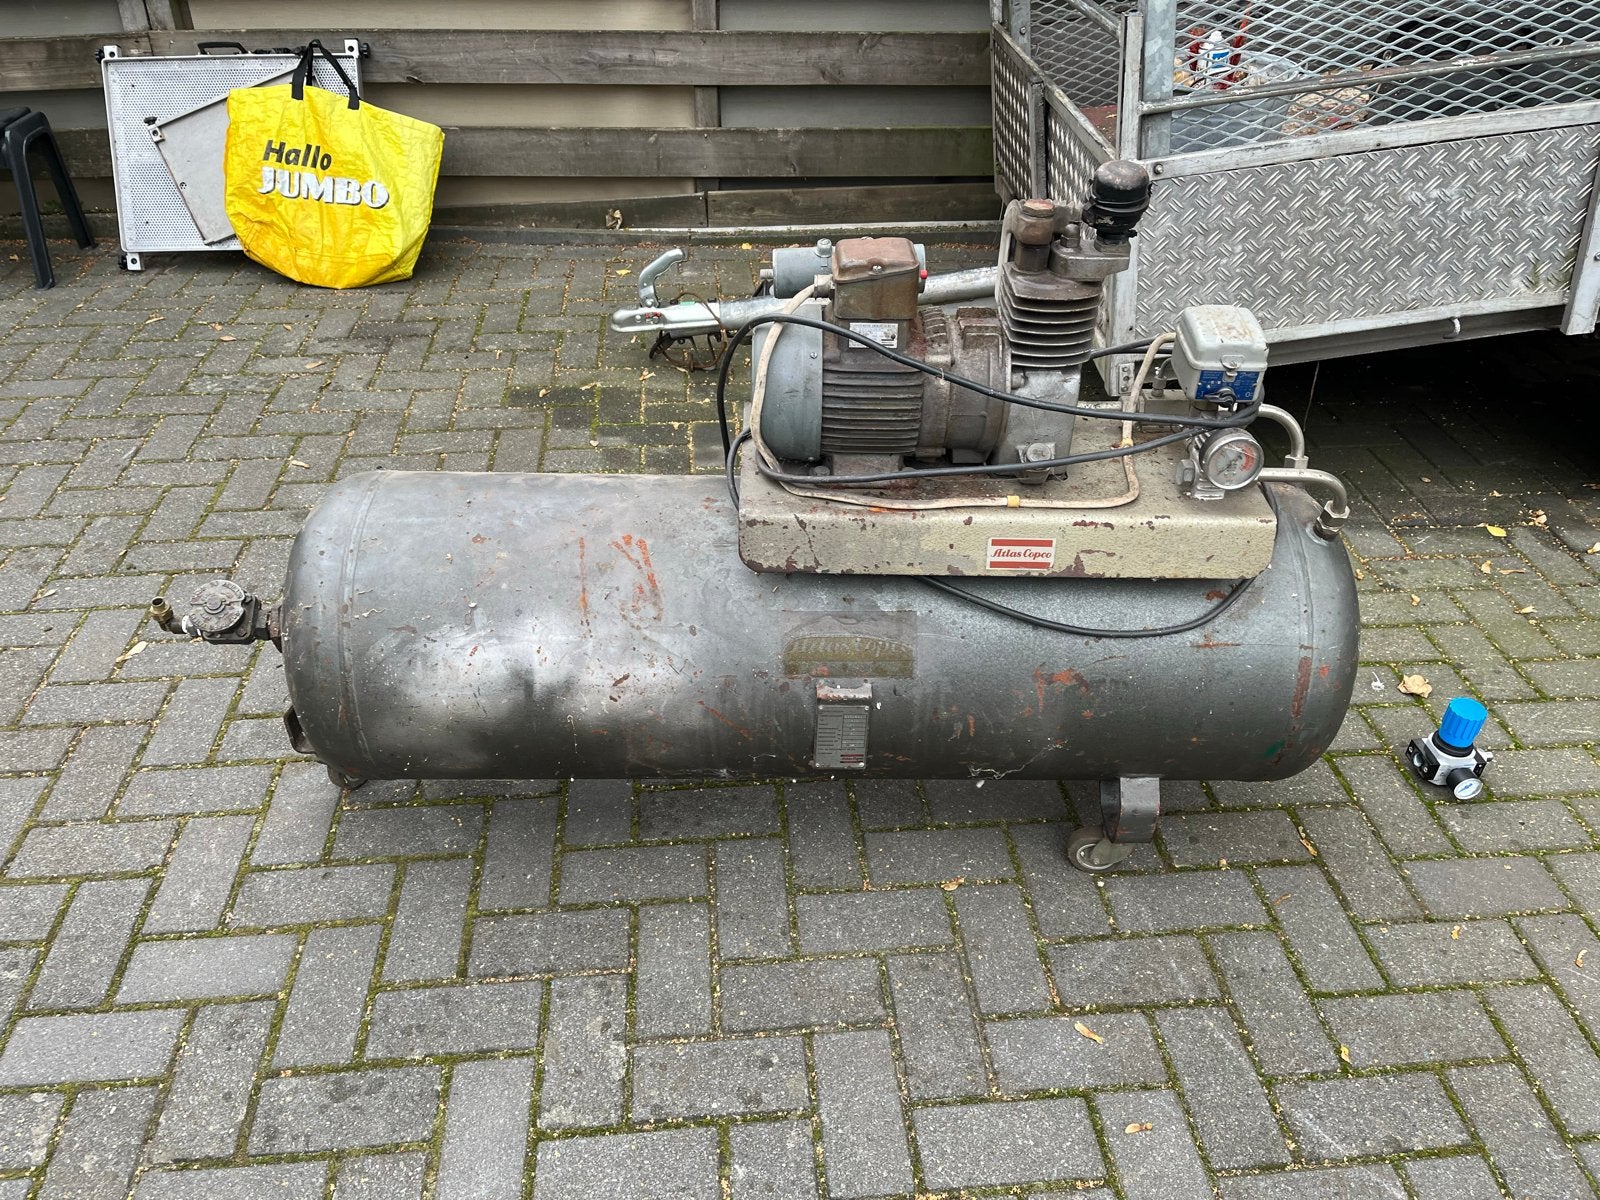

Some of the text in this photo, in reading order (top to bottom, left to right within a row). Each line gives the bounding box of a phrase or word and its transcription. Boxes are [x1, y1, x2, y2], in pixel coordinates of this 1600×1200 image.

[263, 139, 332, 171] Hallo
[258, 166, 389, 209] JUMBO
[991, 548, 1052, 560] Atlas Copco
